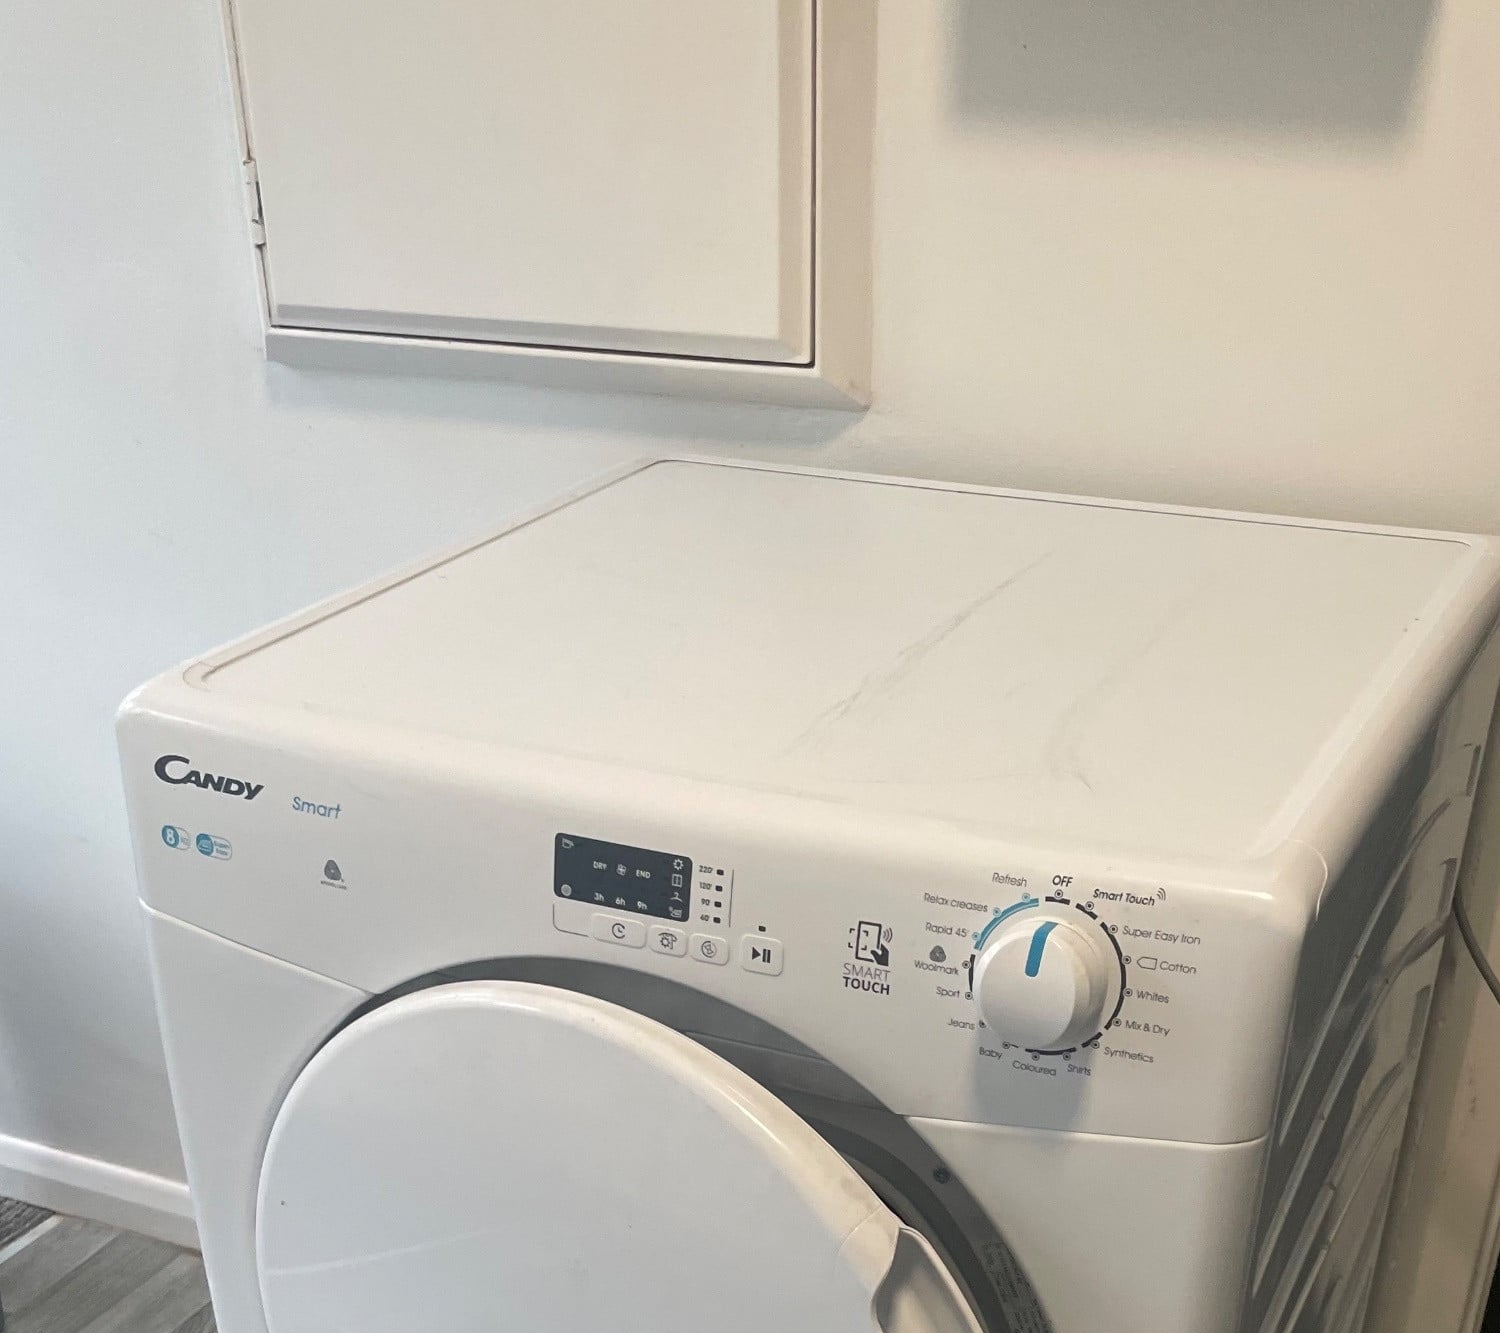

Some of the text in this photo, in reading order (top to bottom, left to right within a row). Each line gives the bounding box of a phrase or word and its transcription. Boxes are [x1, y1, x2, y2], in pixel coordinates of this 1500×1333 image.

[154, 755, 264, 799] CANDY
[292, 797, 342, 818] Smart
[166, 829, 175, 844] 8
[593, 860, 607, 870] DRY
[636, 869, 651, 879] END
[992, 873, 1027, 887] Refresh
[1052, 875, 1073, 887] OFF
[594, 892, 605, 903] 3h
[615, 897, 626, 907] 6h
[924, 892, 988, 913] Relax creases
[1093, 888, 1155, 906] Smart Touch
[637, 901, 648, 911] 9h
[925, 922, 953, 937] Rapid
[1122, 925, 1200, 945] Super Easy Iron
[843, 963, 891, 982] SMART
[914, 961, 959, 976] Woolmark
[1160, 961, 1196, 974] Cotton
[843, 976, 890, 995] TOUCH
[936, 986, 960, 999] Sport
[1136, 989, 1169, 1003] Whites
[947, 1018, 975, 1030] Jeans
[1125, 1020, 1170, 1036] Mix & Dry
[979, 1047, 1003, 1060] Baby
[1104, 1046, 1154, 1063] Synthetics
[1012, 1060, 1057, 1076] Coloured
[1067, 1063, 1091, 1076] Shirts
